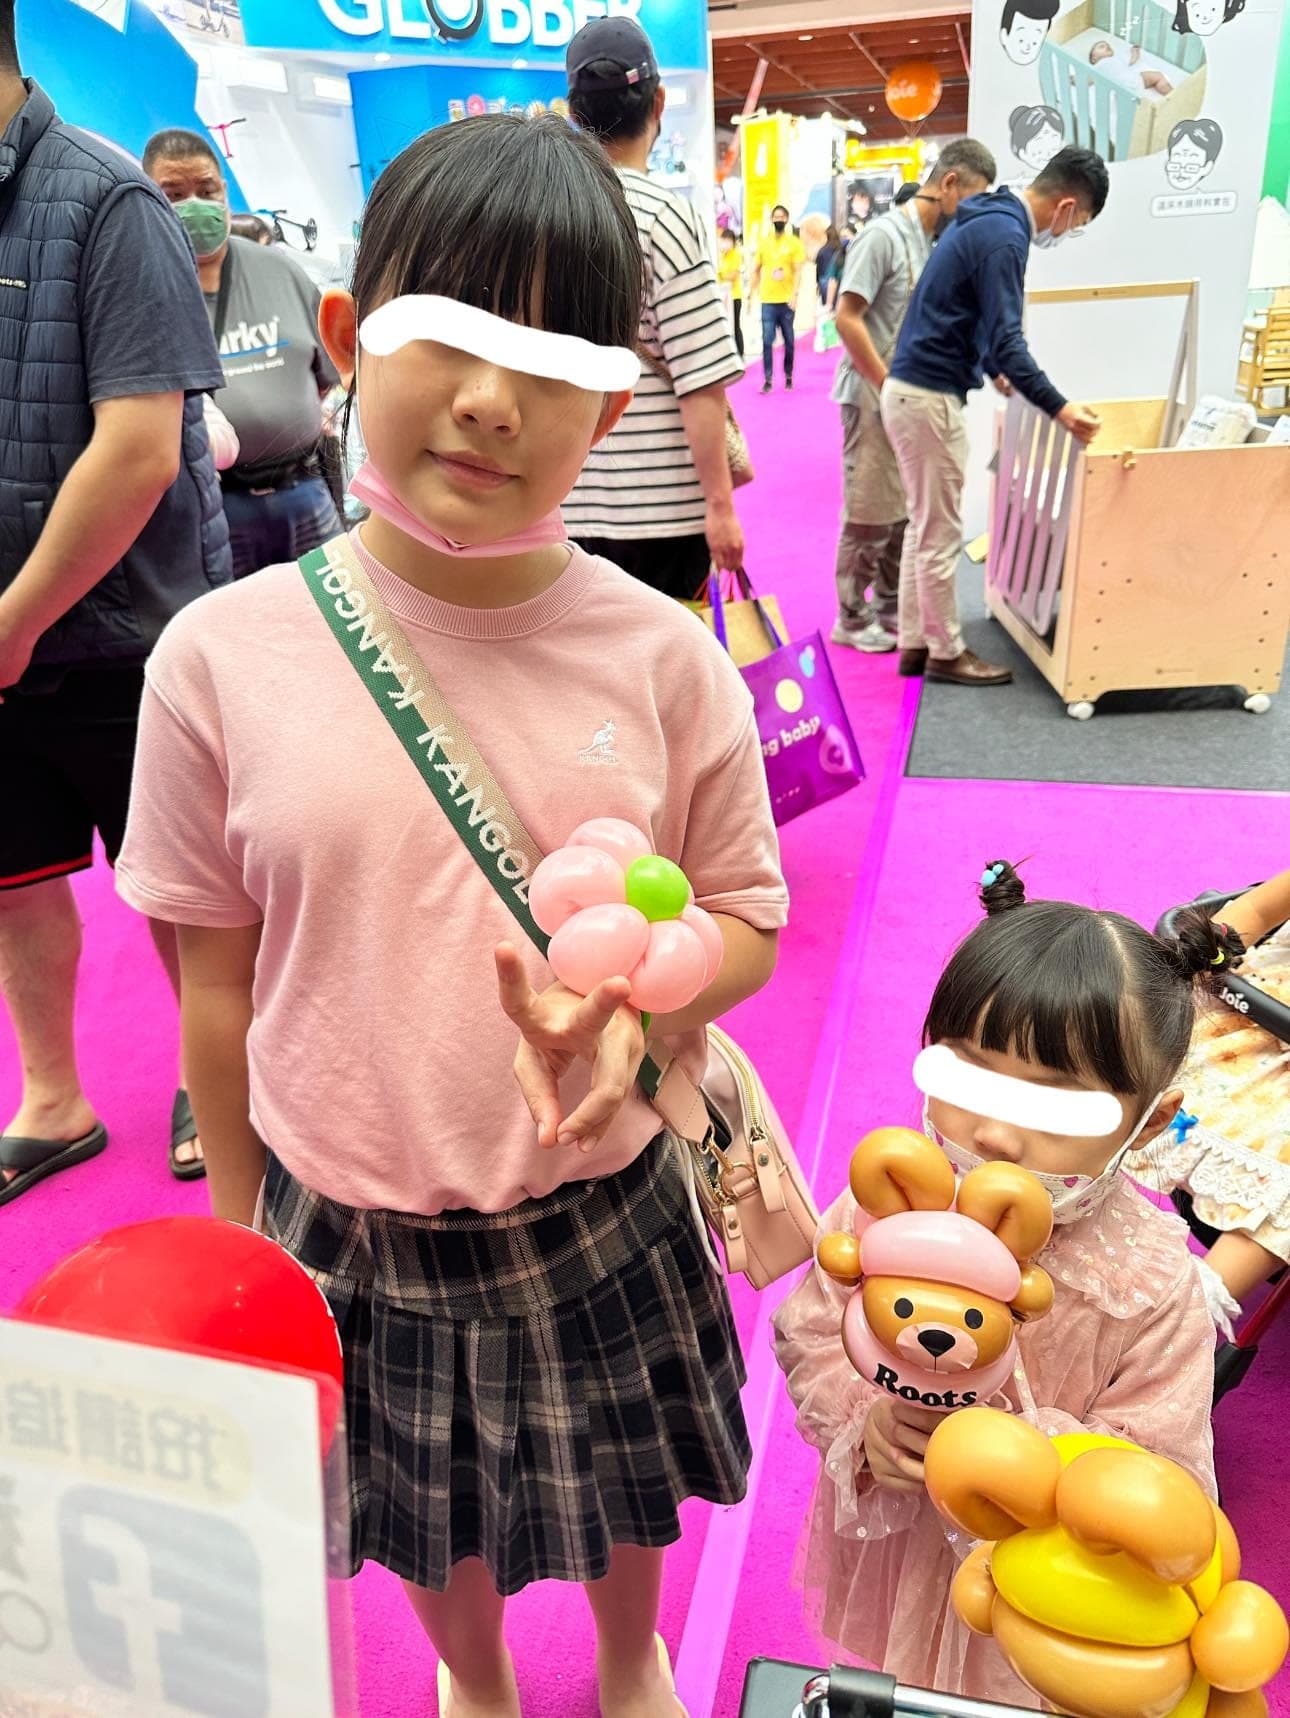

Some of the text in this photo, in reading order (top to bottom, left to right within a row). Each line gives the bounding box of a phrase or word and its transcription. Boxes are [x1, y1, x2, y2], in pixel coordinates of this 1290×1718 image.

[315, 548, 425, 710] KANGOL
[780, 715, 820, 748] baby
[1219, 986, 1249, 1013] Joie
[873, 1362, 977, 1408] Roots
